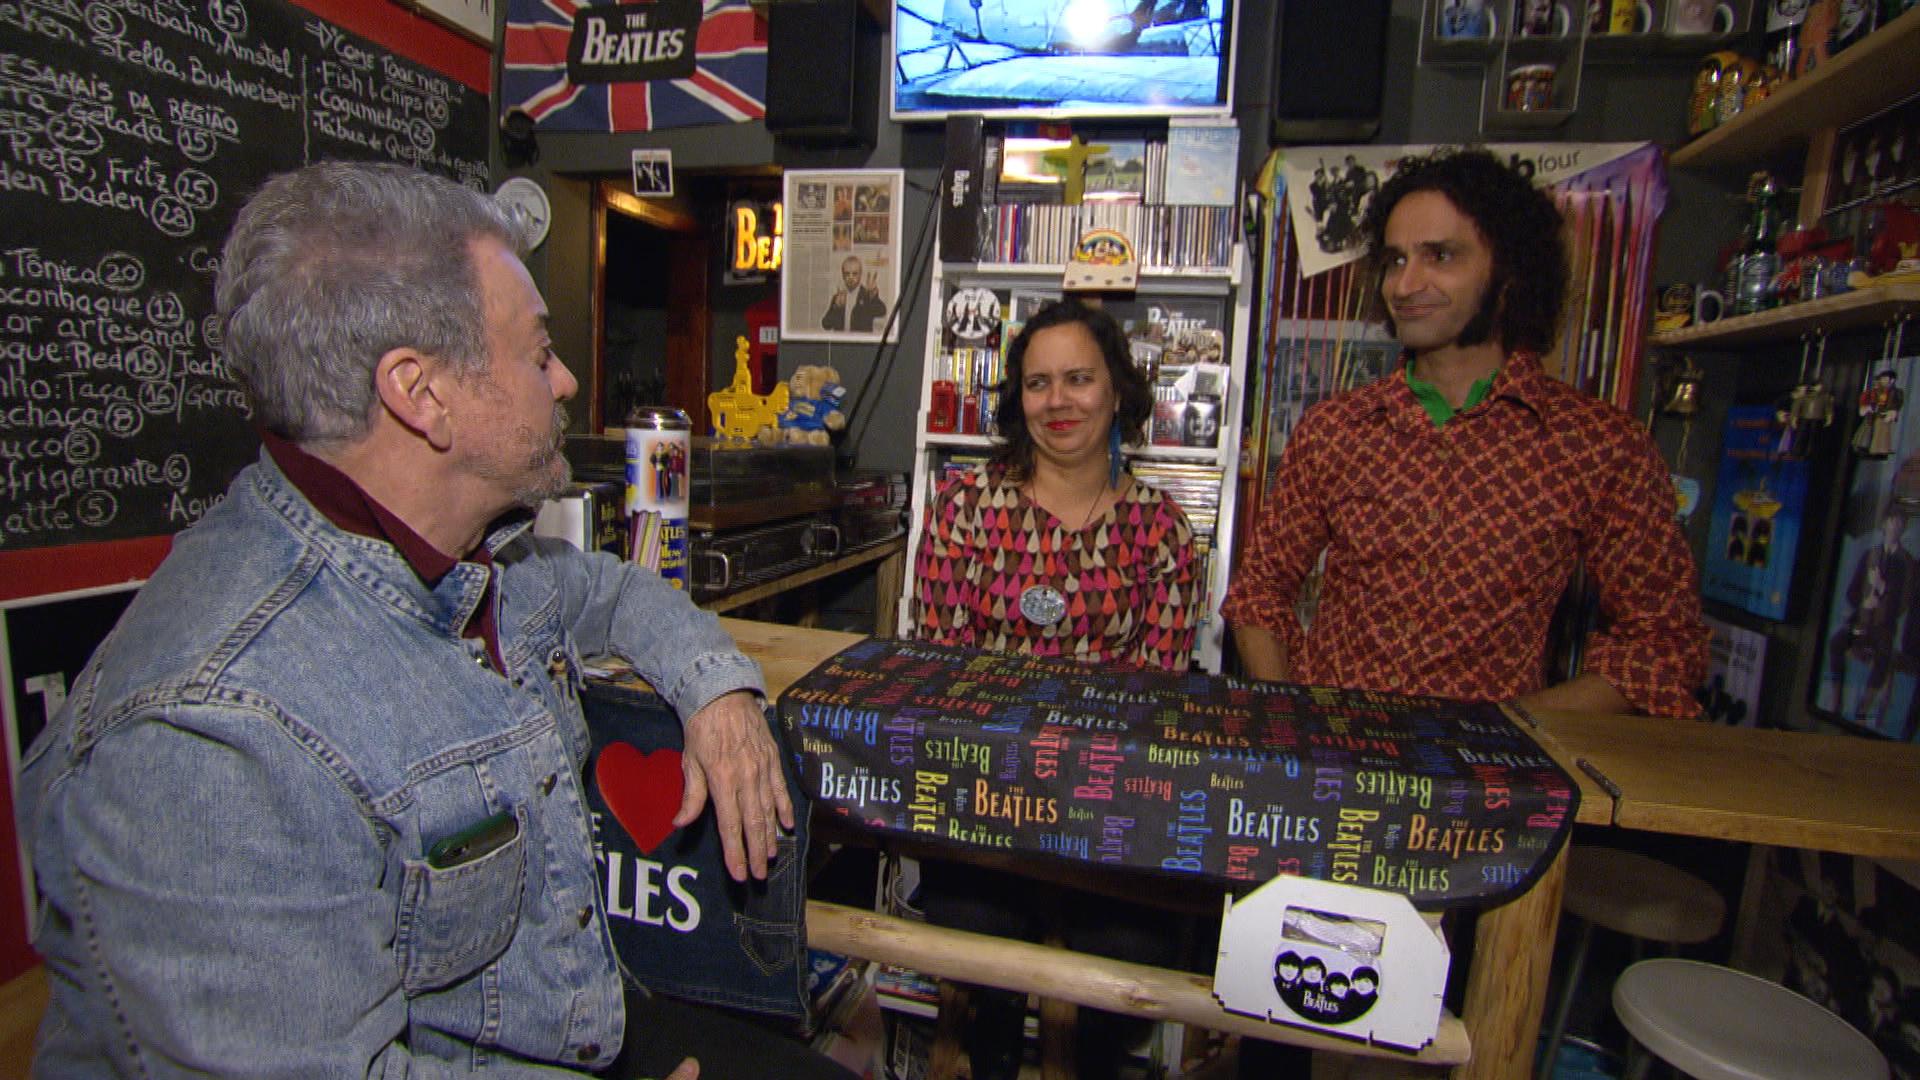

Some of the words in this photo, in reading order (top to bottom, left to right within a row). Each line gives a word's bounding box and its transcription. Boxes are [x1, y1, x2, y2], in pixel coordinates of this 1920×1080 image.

[581, 17, 686, 65] BEATLES
[625, 14, 646, 27] THE
[55, 172, 148, 218] Baden
[800, 703, 879, 746] BEATLES
[925, 736, 991, 774] BEATLES
[1149, 743, 1200, 768] BEATLES
[820, 761, 902, 808] BEATLES
[907, 769, 949, 832] BEATLE
[974, 778, 1058, 828] BEATLES
[1356, 771, 1432, 809] BEATLES
[1161, 788, 1214, 873] BEATLES
[1227, 798, 1320, 847] BEATLES
[1327, 808, 1380, 882] BEATLES
[1408, 814, 1505, 859] BEATLES
[1226, 845, 1260, 880] BEAT
[1373, 855, 1450, 896] BEATLES
[593, 848, 701, 932] LES
